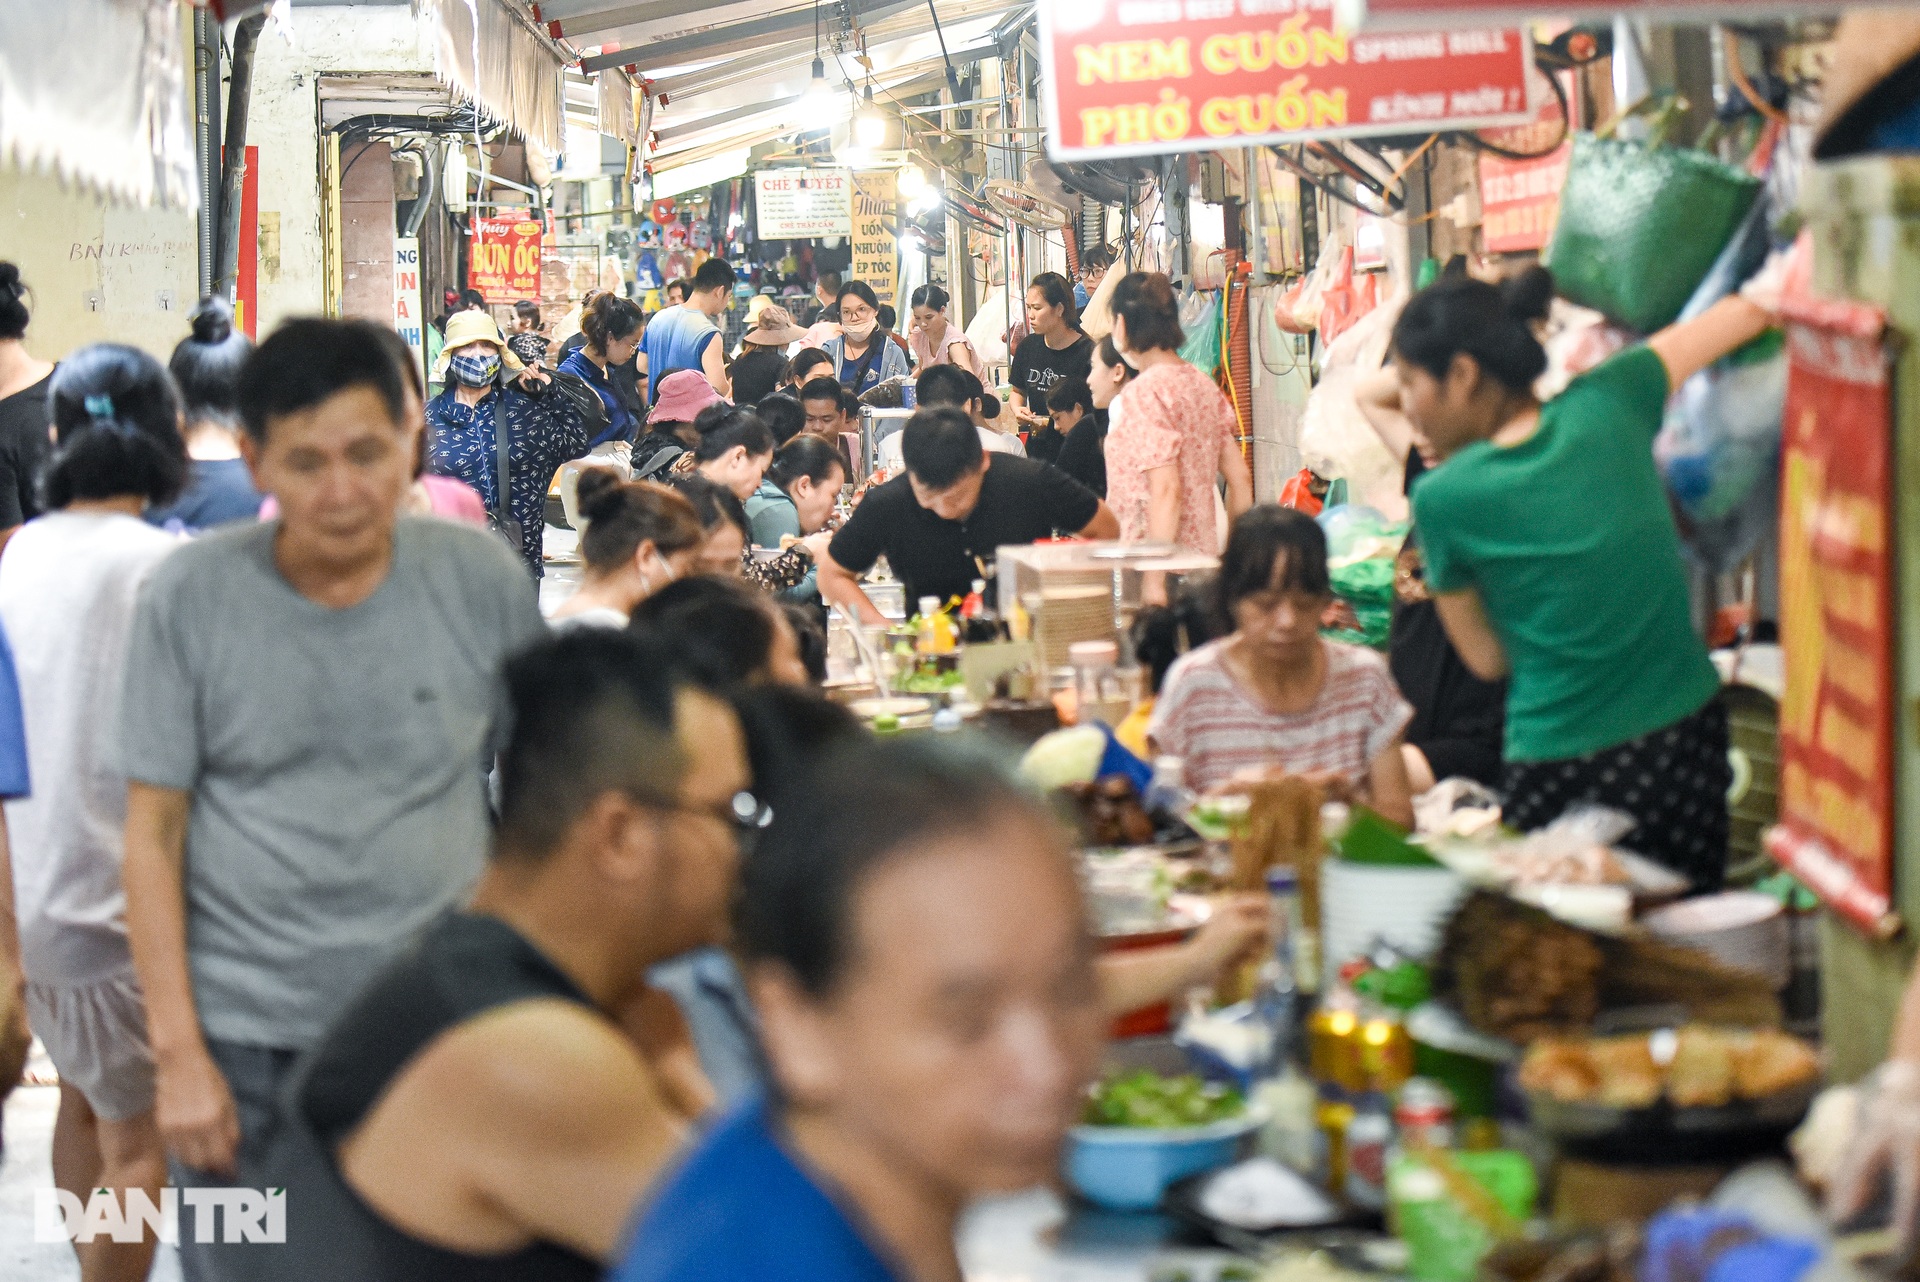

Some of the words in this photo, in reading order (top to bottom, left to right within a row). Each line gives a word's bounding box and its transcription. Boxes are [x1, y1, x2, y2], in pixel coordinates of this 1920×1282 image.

[1075, 38, 1192, 85] NEM
[1202, 12, 1348, 75] CUỐN
[1081, 88, 1190, 148] PHỞ
[1201, 74, 1348, 137] CUỐN
[763, 176, 791, 191] CHÈ
[861, 218, 884, 236] UỐN
[472, 239, 510, 274] BÚN
[513, 236, 539, 275] ỐC
[854, 239, 892, 256] NHUỘM
[856, 258, 869, 274] ÉP
[871, 258, 892, 273] TÓC
